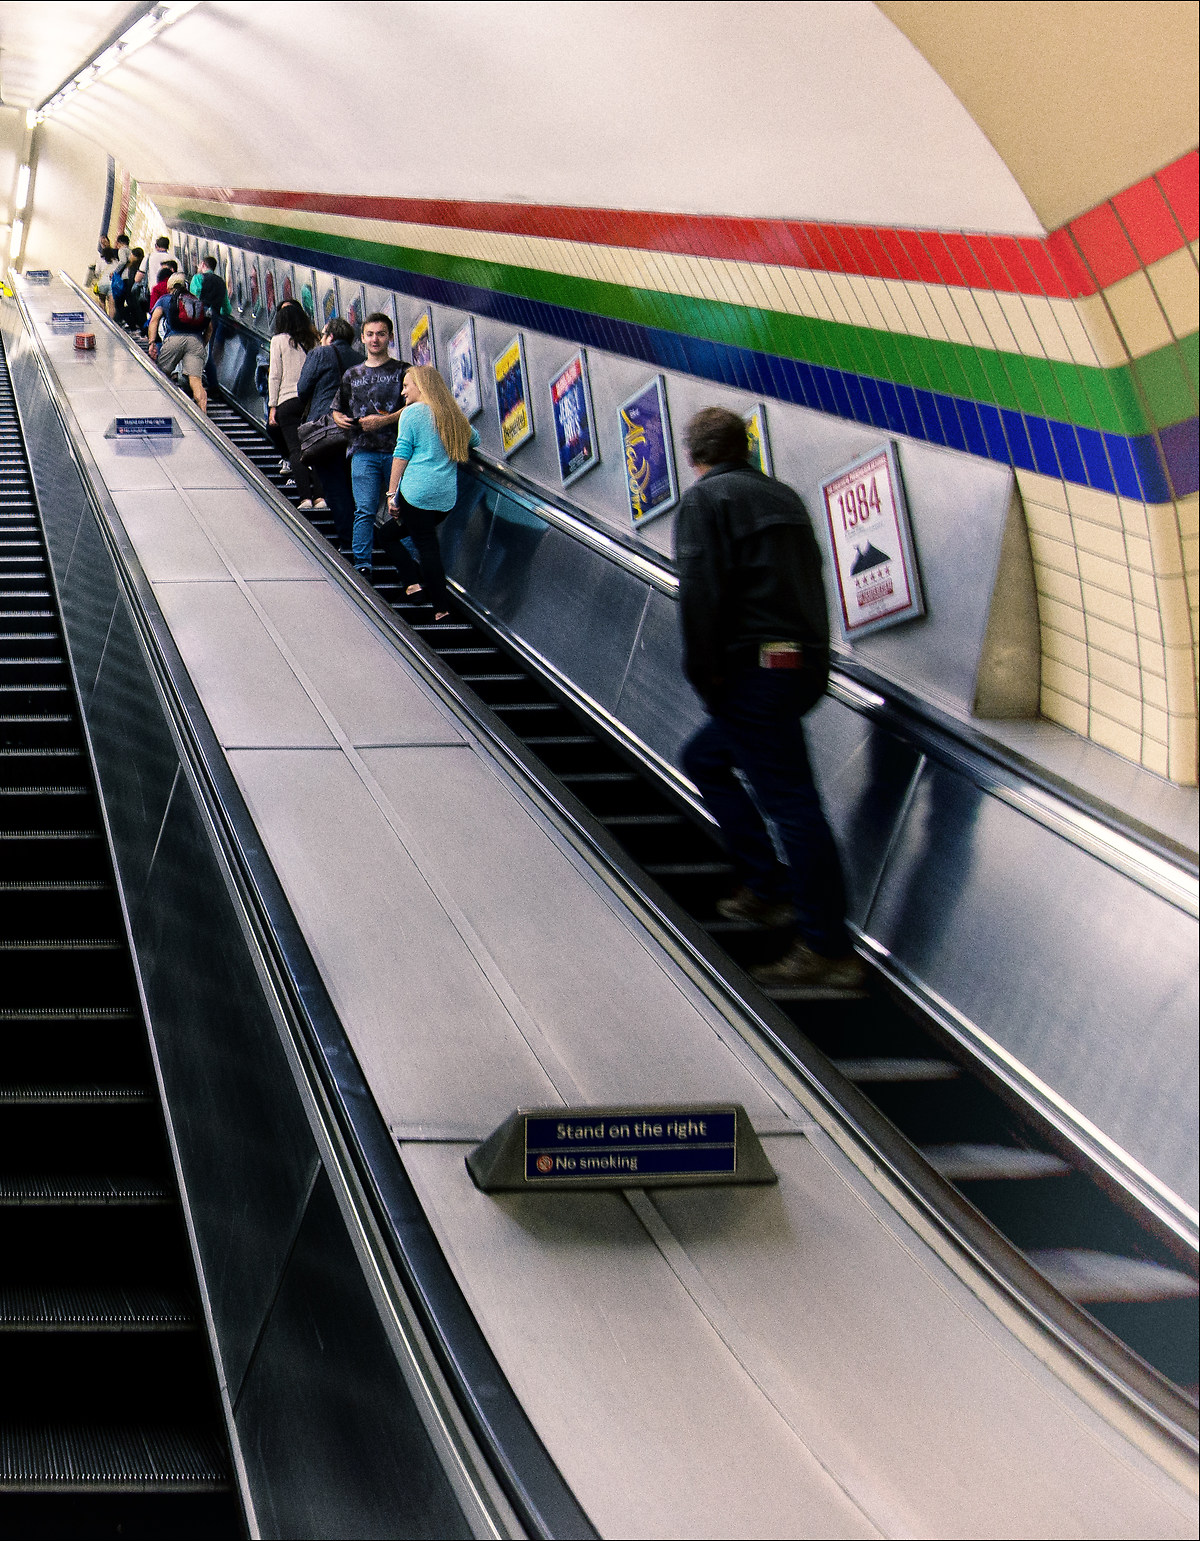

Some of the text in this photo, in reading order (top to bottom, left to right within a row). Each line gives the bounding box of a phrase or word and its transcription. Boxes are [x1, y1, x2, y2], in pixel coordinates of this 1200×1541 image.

[838, 474, 881, 531] 1984
[556, 1119, 708, 1140] Stand on the right
[556, 1155, 638, 1170] No smoking
